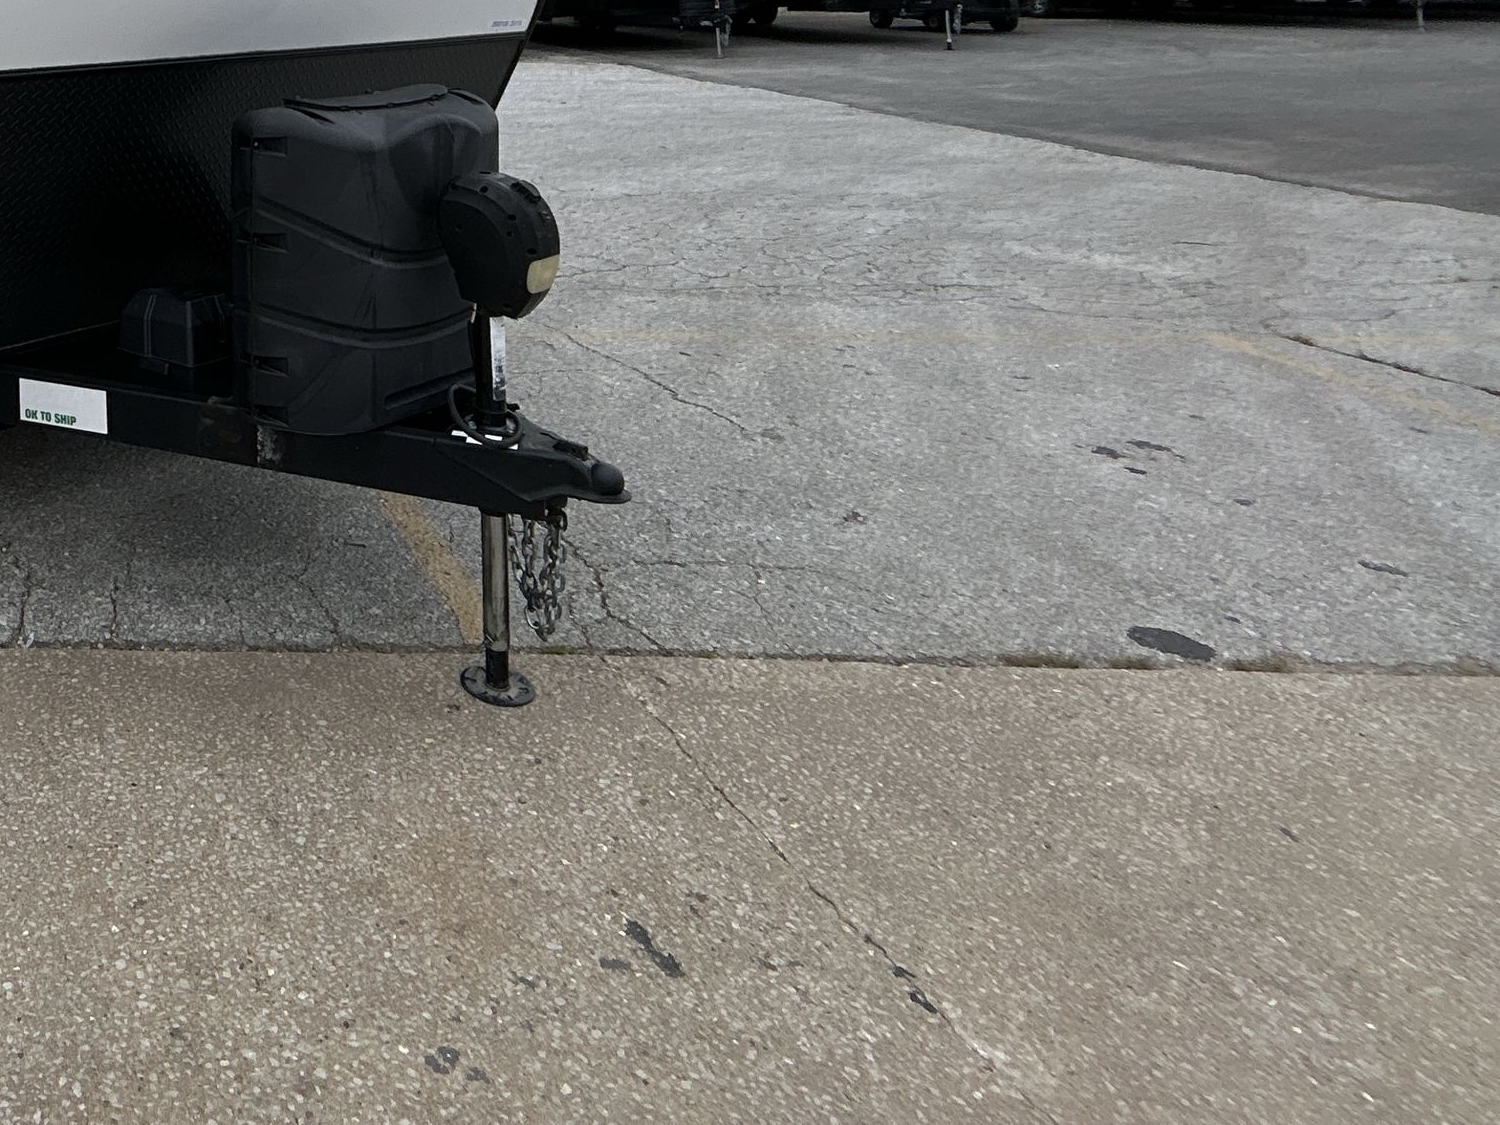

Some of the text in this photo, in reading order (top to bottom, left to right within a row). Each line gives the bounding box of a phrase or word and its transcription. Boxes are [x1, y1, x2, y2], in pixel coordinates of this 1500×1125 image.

[24, 408, 77, 426] OK TO SHIP
